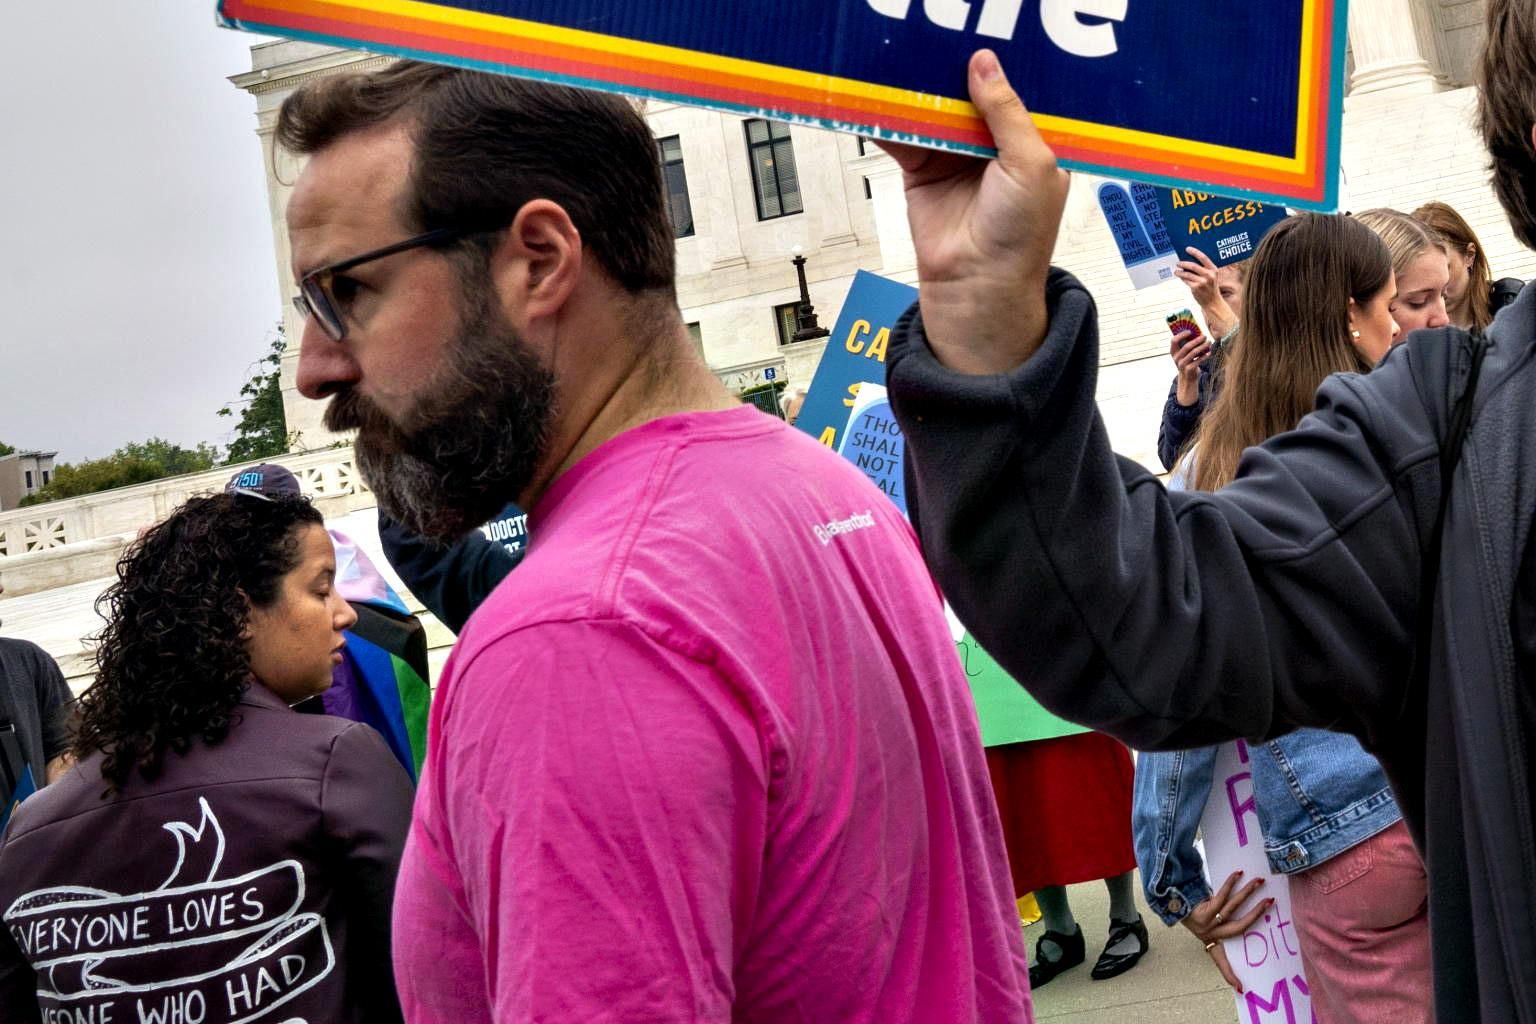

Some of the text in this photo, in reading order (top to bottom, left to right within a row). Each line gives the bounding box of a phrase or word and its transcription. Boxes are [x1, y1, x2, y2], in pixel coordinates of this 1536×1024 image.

[1135, 191, 1157, 204] SHAL
[1113, 221, 1136, 233] STEAL
[1188, 200, 1265, 235] ACCESS!
[1216, 232, 1249, 249] CATHOLICS
[1218, 241, 1253, 260] CHOICE
[864, 414, 901, 436] THO
[852, 432, 900, 457] SHAL
[856, 453, 898, 475] NOT
[168, 887, 264, 935] LOVES
[137, 990, 206, 1024] WHO
[226, 955, 306, 1016] HAD
